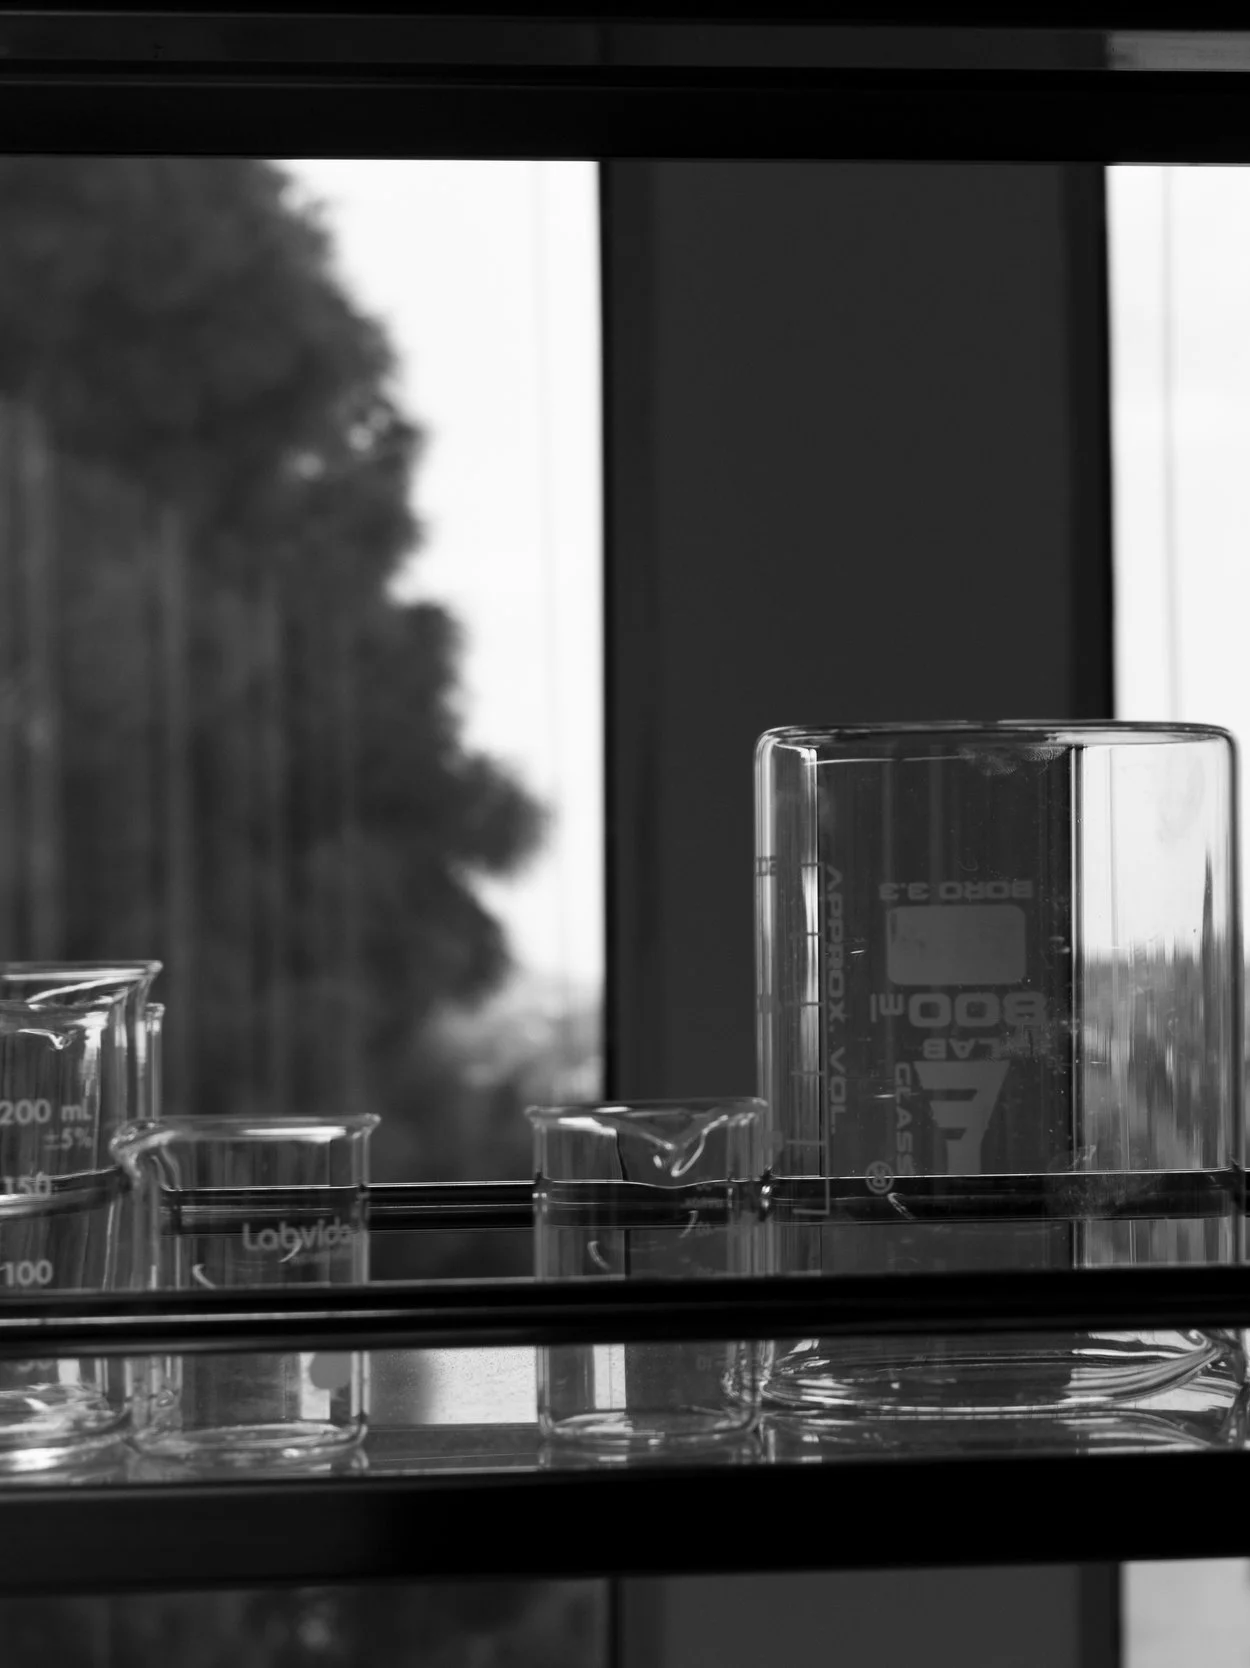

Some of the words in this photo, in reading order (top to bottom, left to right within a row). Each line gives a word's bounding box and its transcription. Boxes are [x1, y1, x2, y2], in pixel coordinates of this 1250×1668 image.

[878, 882, 931, 901] 3.3
[939, 880, 1034, 900] BORO
[922, 1037, 1002, 1060] LAB
[0, 1099, 51, 1124] 200
[2, 1260, 53, 1286] 100
